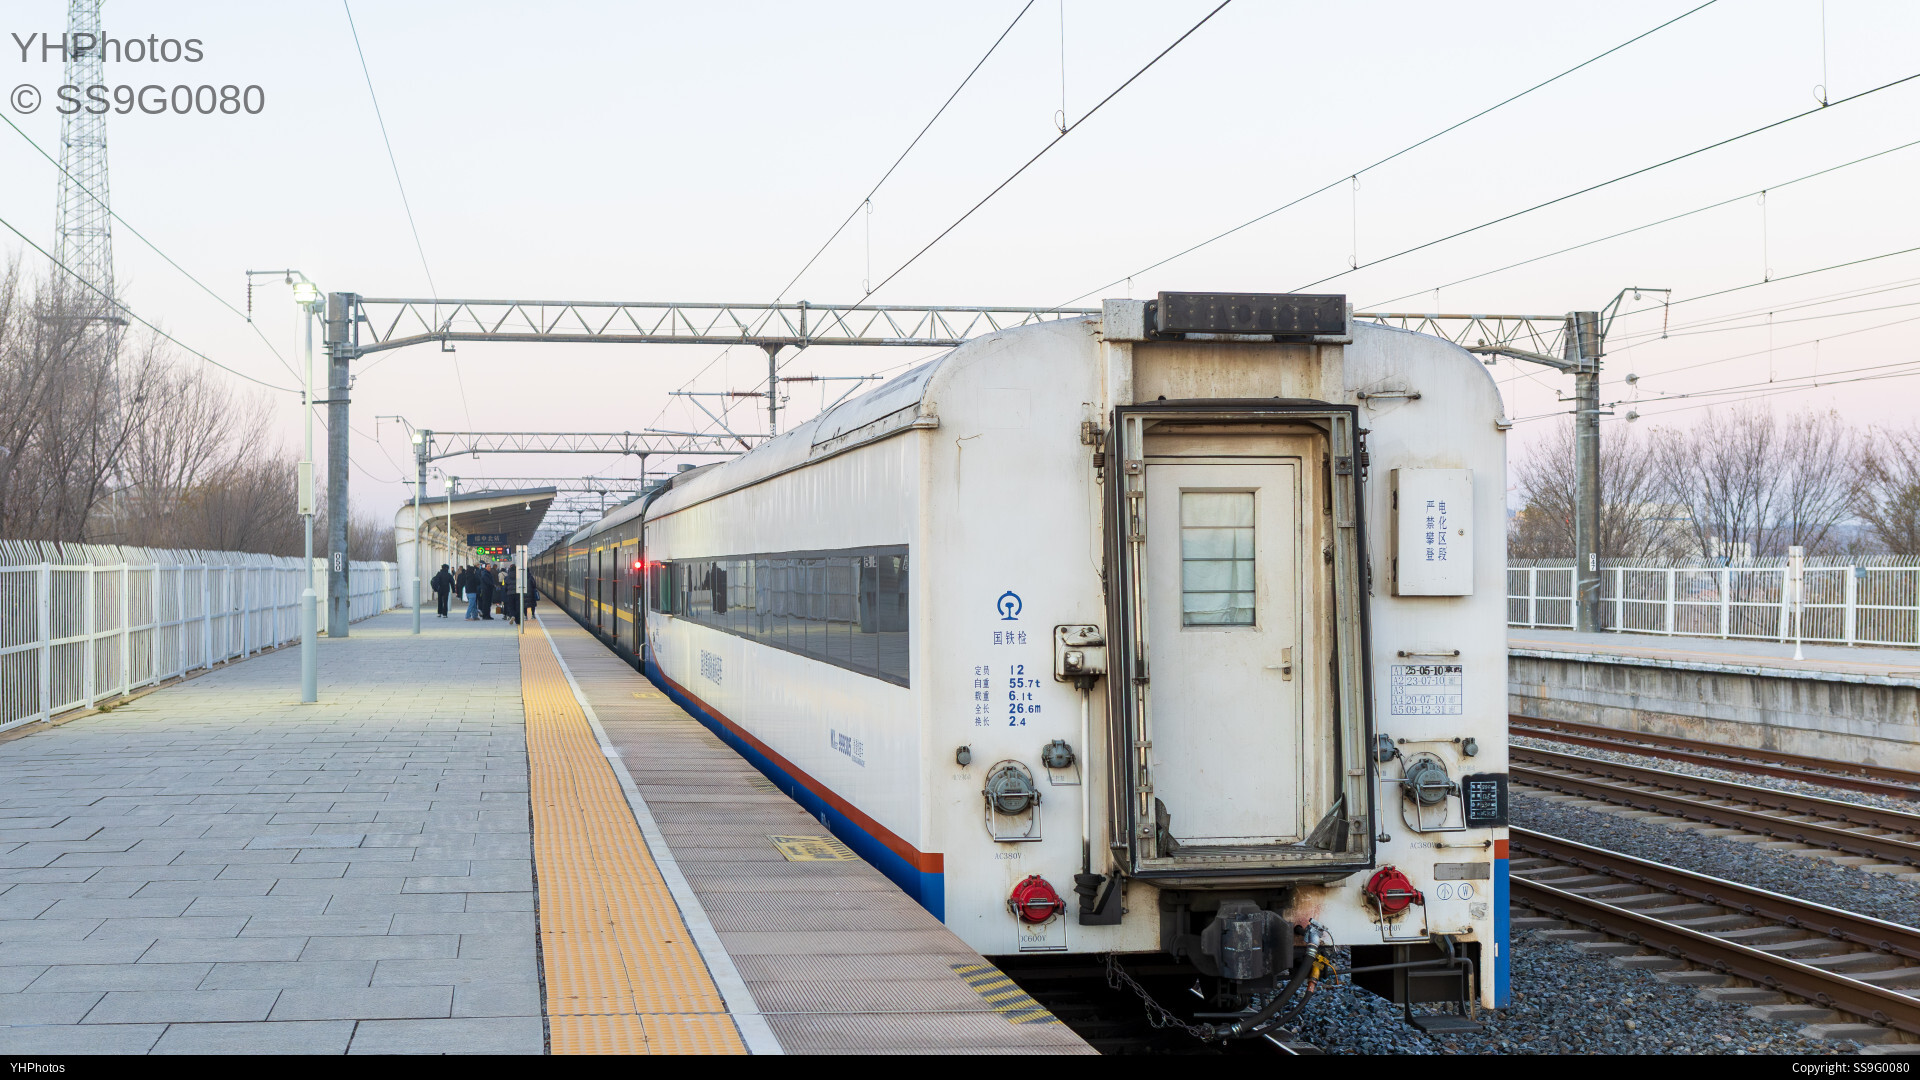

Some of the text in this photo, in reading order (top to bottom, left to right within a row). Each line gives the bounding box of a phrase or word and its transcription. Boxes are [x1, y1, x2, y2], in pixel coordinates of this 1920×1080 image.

[1425, 500, 1435, 561] 严禁攀登
[1438, 500, 1447, 561] 电化区段
[993, 630, 1027, 645] 国铁检
[975, 664, 1024, 676] 定员 12
[1406, 666, 1443, 675] 25-05-10
[974, 677, 1041, 689] 自重 55.7t
[1394, 676, 1404, 685] A2
[974, 690, 1033, 701] 载重 6.1t
[1394, 686, 1404, 695] A3
[975, 702, 1041, 714] 全长 26.6m
[1394, 705, 1404, 714] A5
[974, 715, 1026, 727] 换长 2.4
[994, 852, 1022, 860] AC380V
